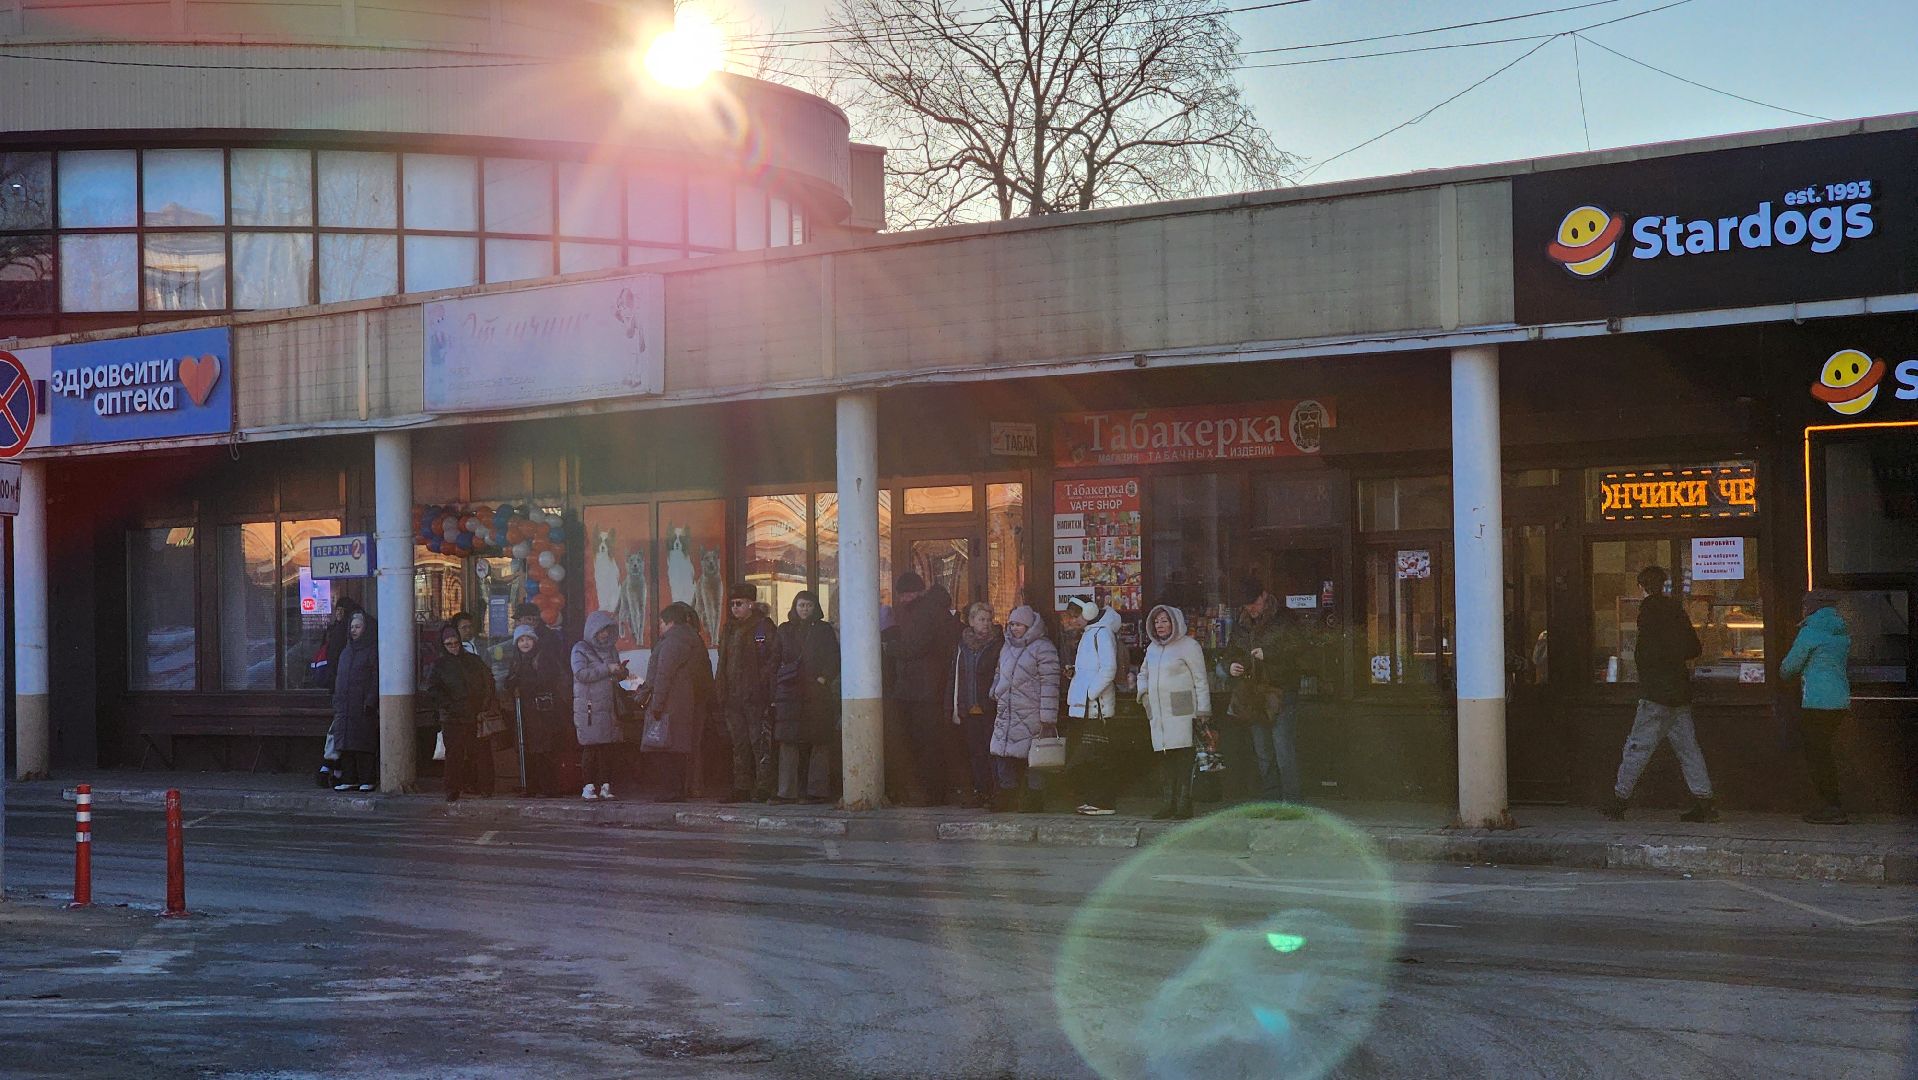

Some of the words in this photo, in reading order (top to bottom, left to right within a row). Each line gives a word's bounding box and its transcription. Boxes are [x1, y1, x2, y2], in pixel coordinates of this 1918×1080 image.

[1784, 185, 1822, 206] est.
[1825, 180, 1872, 201] 1993
[1632, 201, 1874, 260] Stardogs
[51, 358, 174, 399] здравсити
[94, 386, 174, 416] аптека
[1084, 411, 1284, 458] Табакерка
[1098, 452, 1139, 463] МАГАЗИН
[1148, 448, 1214, 461] ТАБАЧНЫХ
[1064, 483, 1125, 498] Табакерка
[1070, 501, 1094, 510] VAPE
[1097, 500, 1122, 509] SHOP
[316, 545, 349, 557] ПЕРРОН
[353, 540, 361, 559] 2
[329, 562, 350, 574] РУЗА
